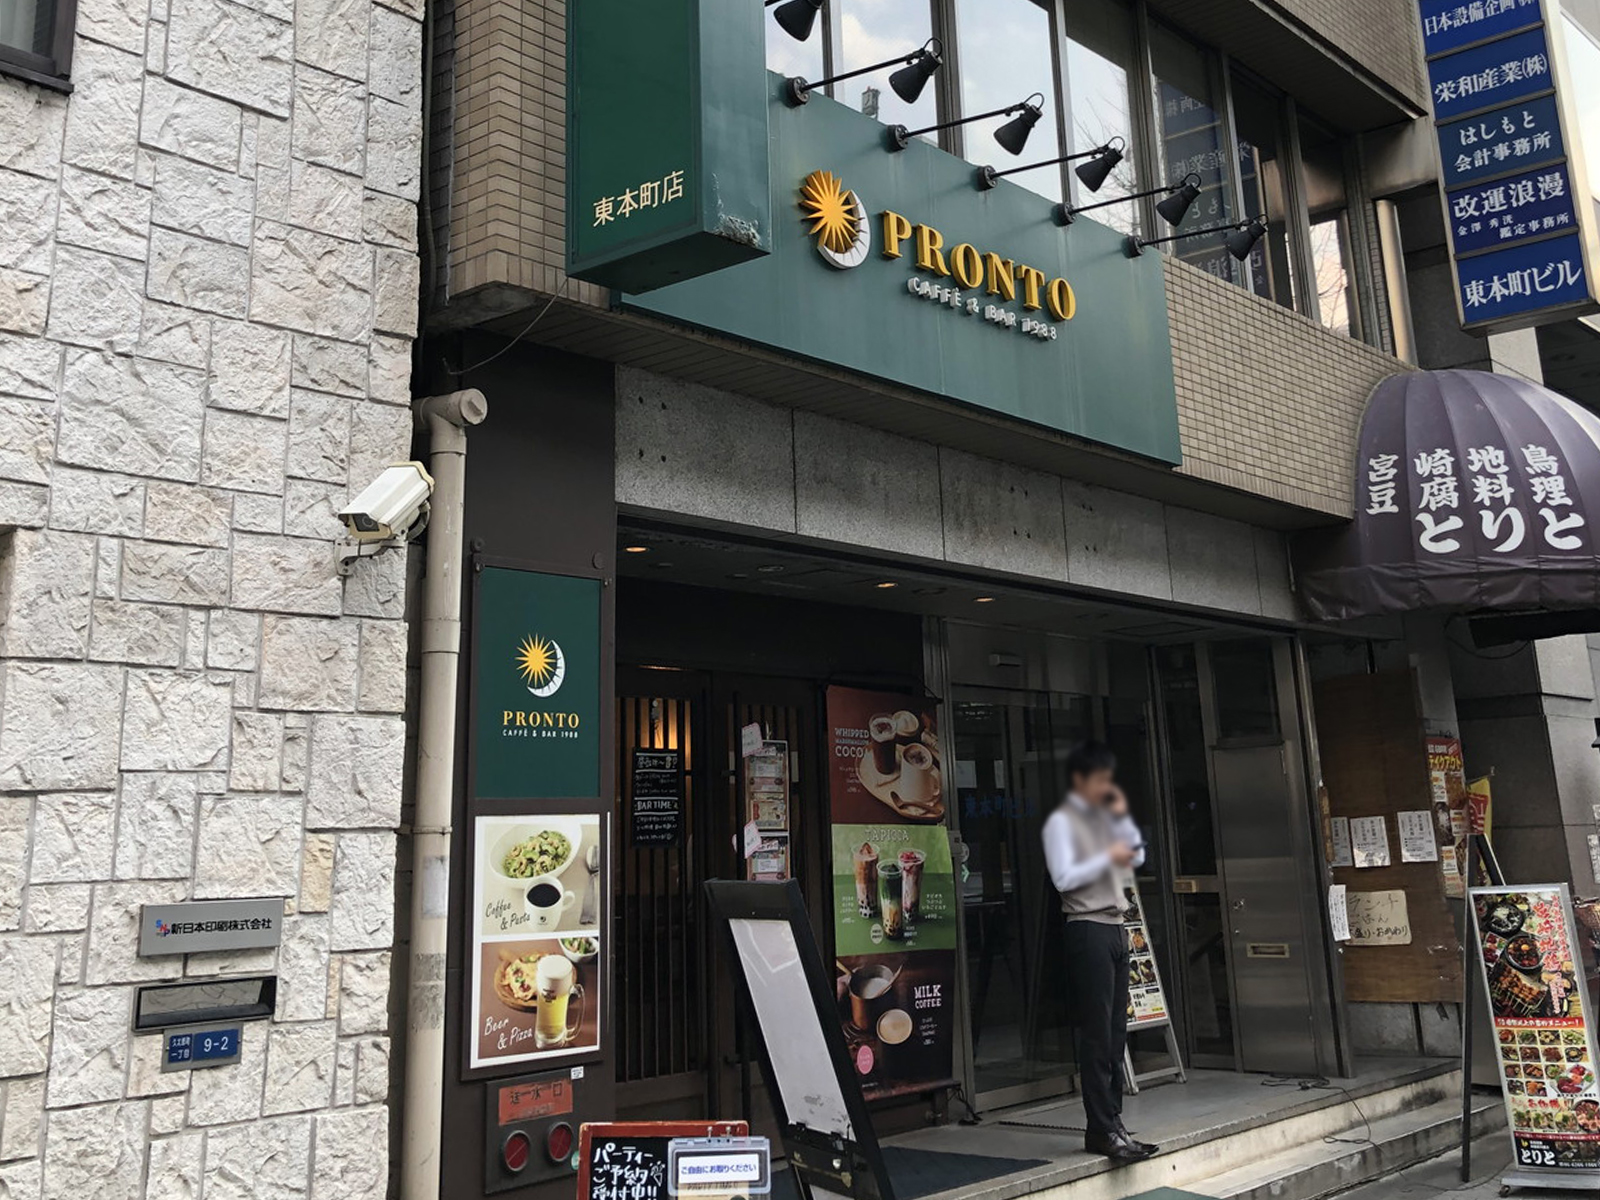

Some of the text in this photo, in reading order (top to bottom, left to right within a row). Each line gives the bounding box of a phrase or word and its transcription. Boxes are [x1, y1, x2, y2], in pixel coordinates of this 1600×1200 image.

[1423, 0, 1535, 36] 日本設備企画
[1459, 110, 1536, 146] はしもと
[1454, 131, 1551, 172] 会計事務所
[592, 169, 684, 228] 東本町店
[1453, 171, 1565, 221] 改運浪漫
[882, 209, 1076, 322] PRONTO
[1463, 259, 1582, 308] 東本町ビル
[966, 296, 980, 314] &
[984, 304, 1017, 328] BAR
[1021, 317, 1058, 341] 1988
[1414, 506, 1585, 554] とりと
[502, 710, 580, 729] PRONTO
[541, 730, 558, 738] BAR
[560, 731, 579, 739] 1988
[834, 727, 870, 739] WHIPPED
[637, 800, 653, 811] BAR
[484, 900, 512, 920] Coffee
[1348, 893, 1399, 912] ランチ
[170, 917, 273, 936] 新日本印刷株式会社
[500, 911, 531, 931] & Pasta
[913, 984, 942, 999] MILK
[914, 997, 942, 1010] COFFEE
[484, 1015, 510, 1037] Beer
[203, 1035, 229, 1053] 9-2
[496, 1024, 534, 1050] & Pizza
[592, 1142, 654, 1164] パーティー
[1520, 1148, 1556, 1166] とりと
[592, 1164, 649, 1186] ご予約
[680, 1163, 758, 1176] ご自由にお取りください
